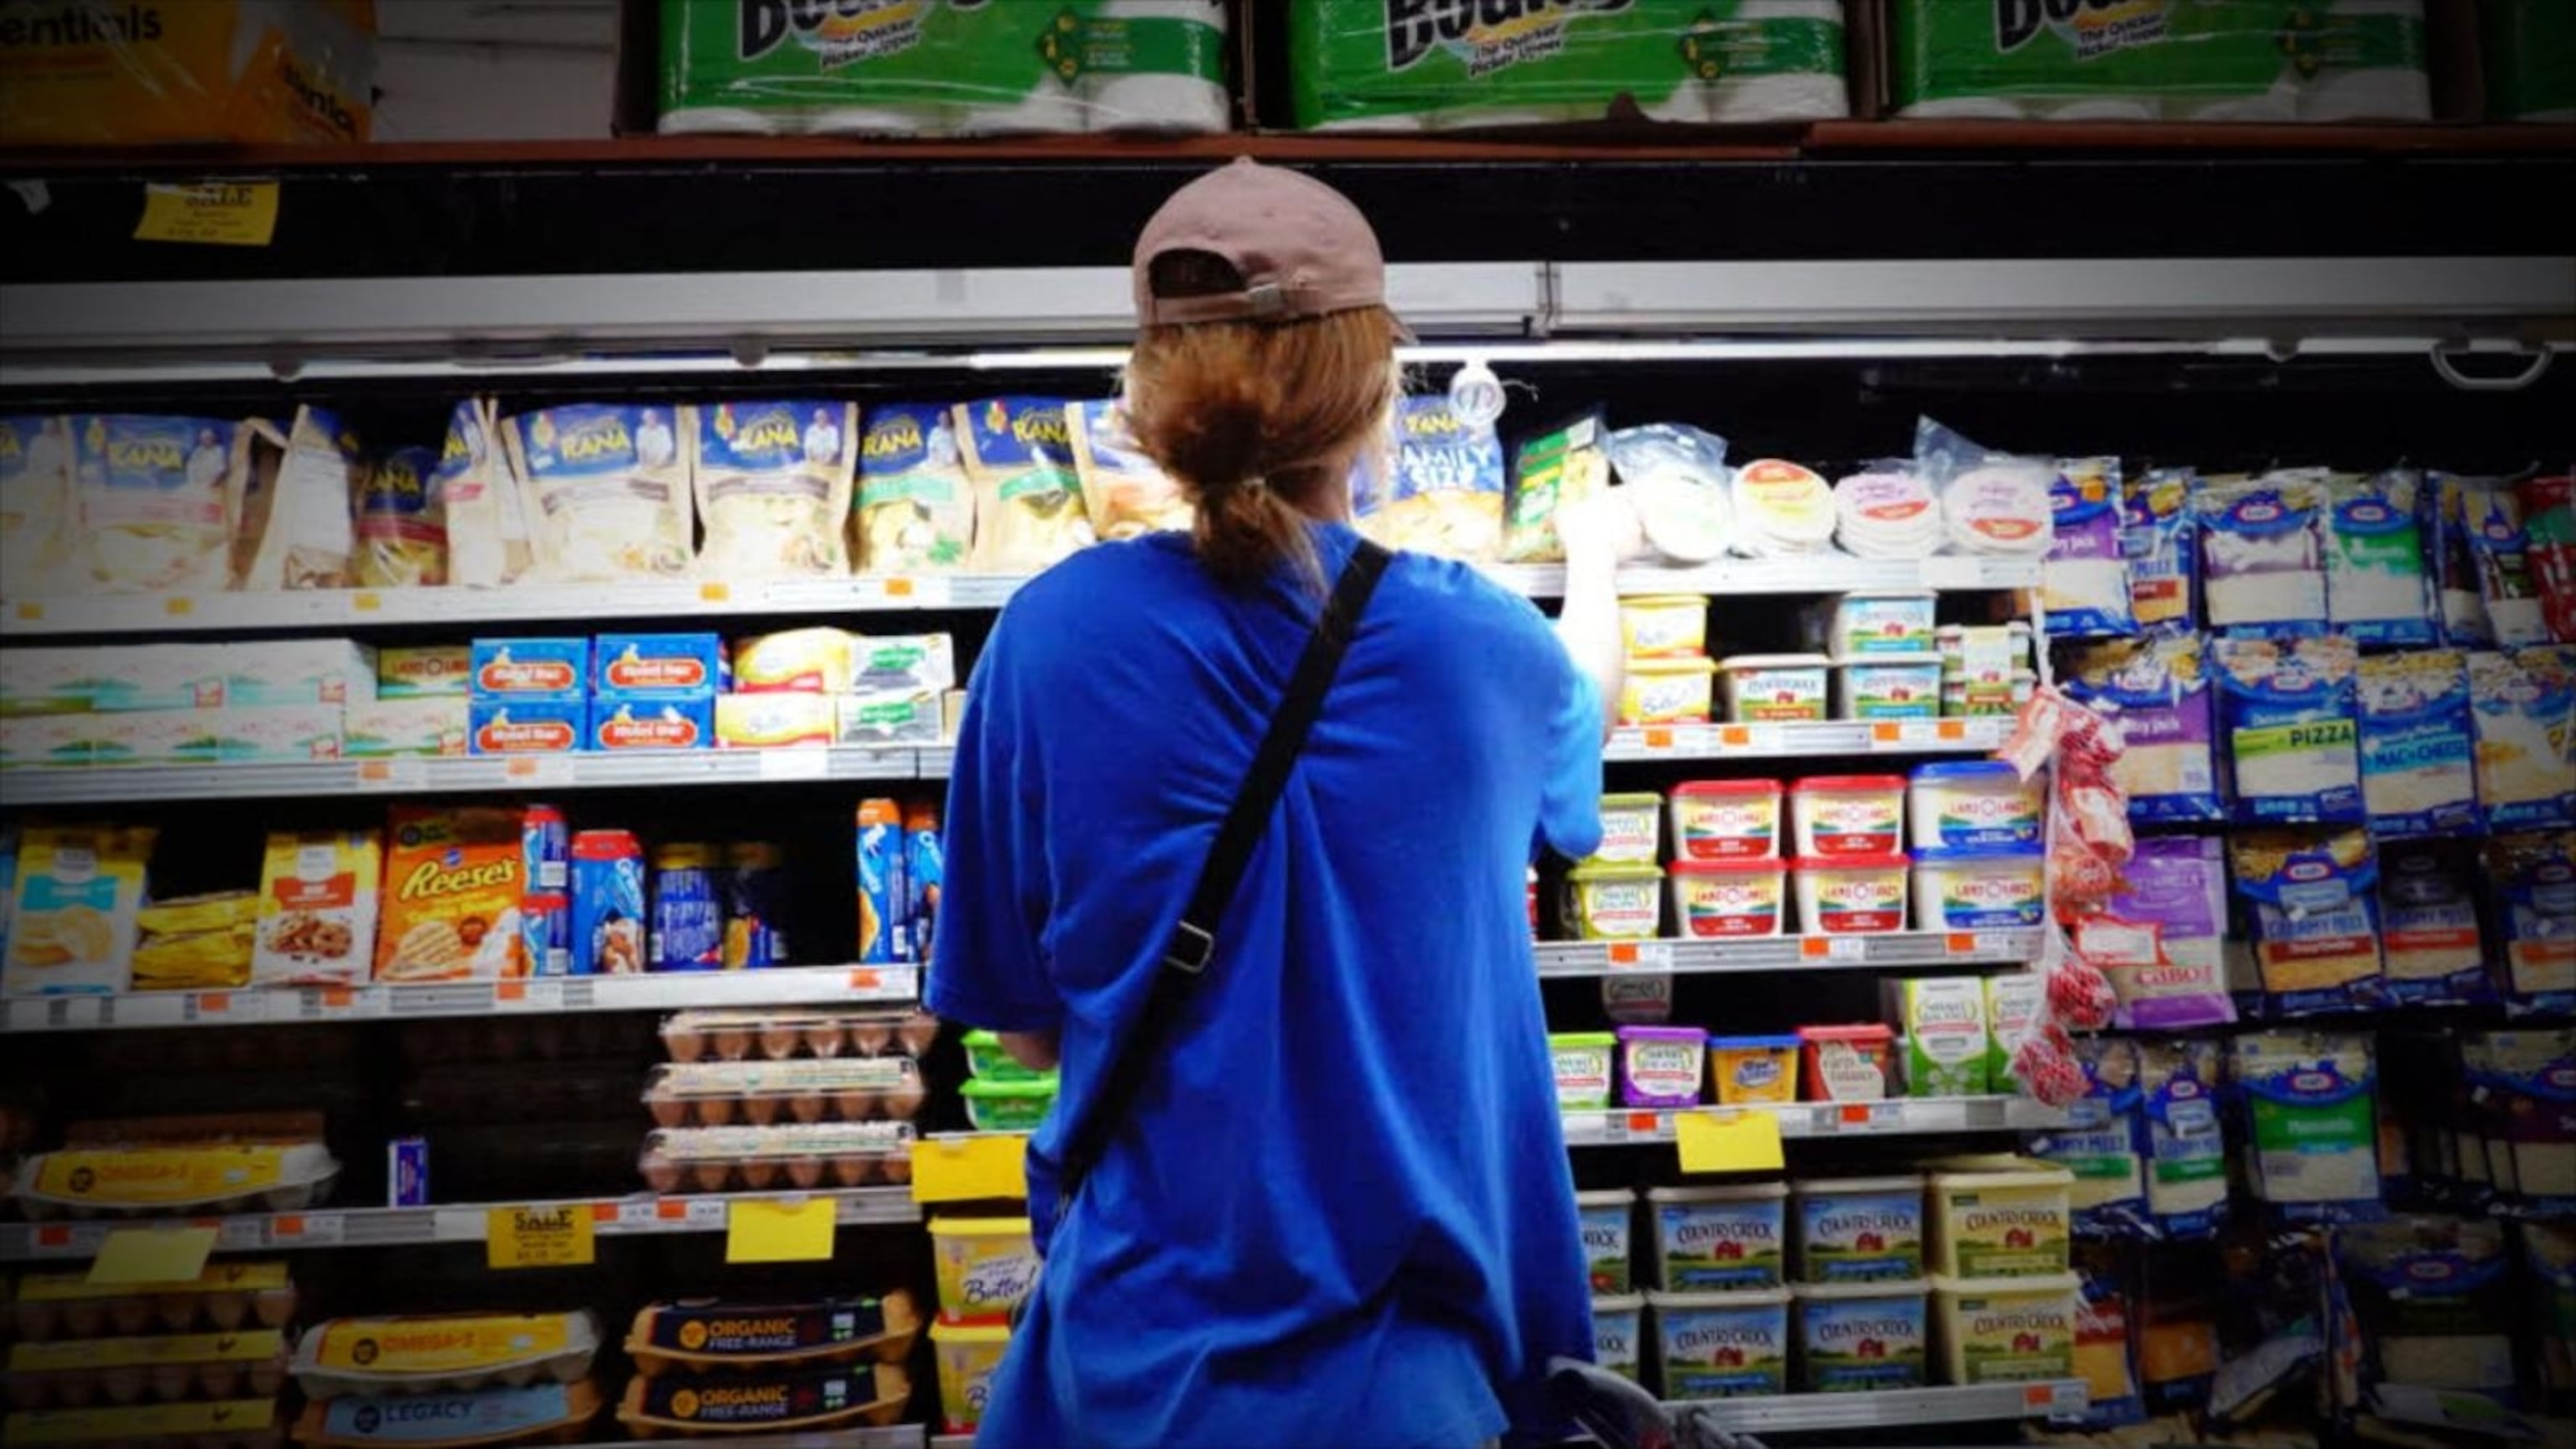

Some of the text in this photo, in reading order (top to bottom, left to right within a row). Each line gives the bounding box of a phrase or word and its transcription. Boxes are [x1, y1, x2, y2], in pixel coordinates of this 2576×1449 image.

[863, 427, 922, 456] RANA
[1402, 443, 1491, 471] AMILY
[2291, 722, 2353, 746] PIZZA
[512, 1208, 574, 1231] SALE
[709, 1318, 797, 1337] ORGANIC
[700, 1385, 789, 1405] ORGANIC
[385, 1400, 476, 1423] LEGACY
